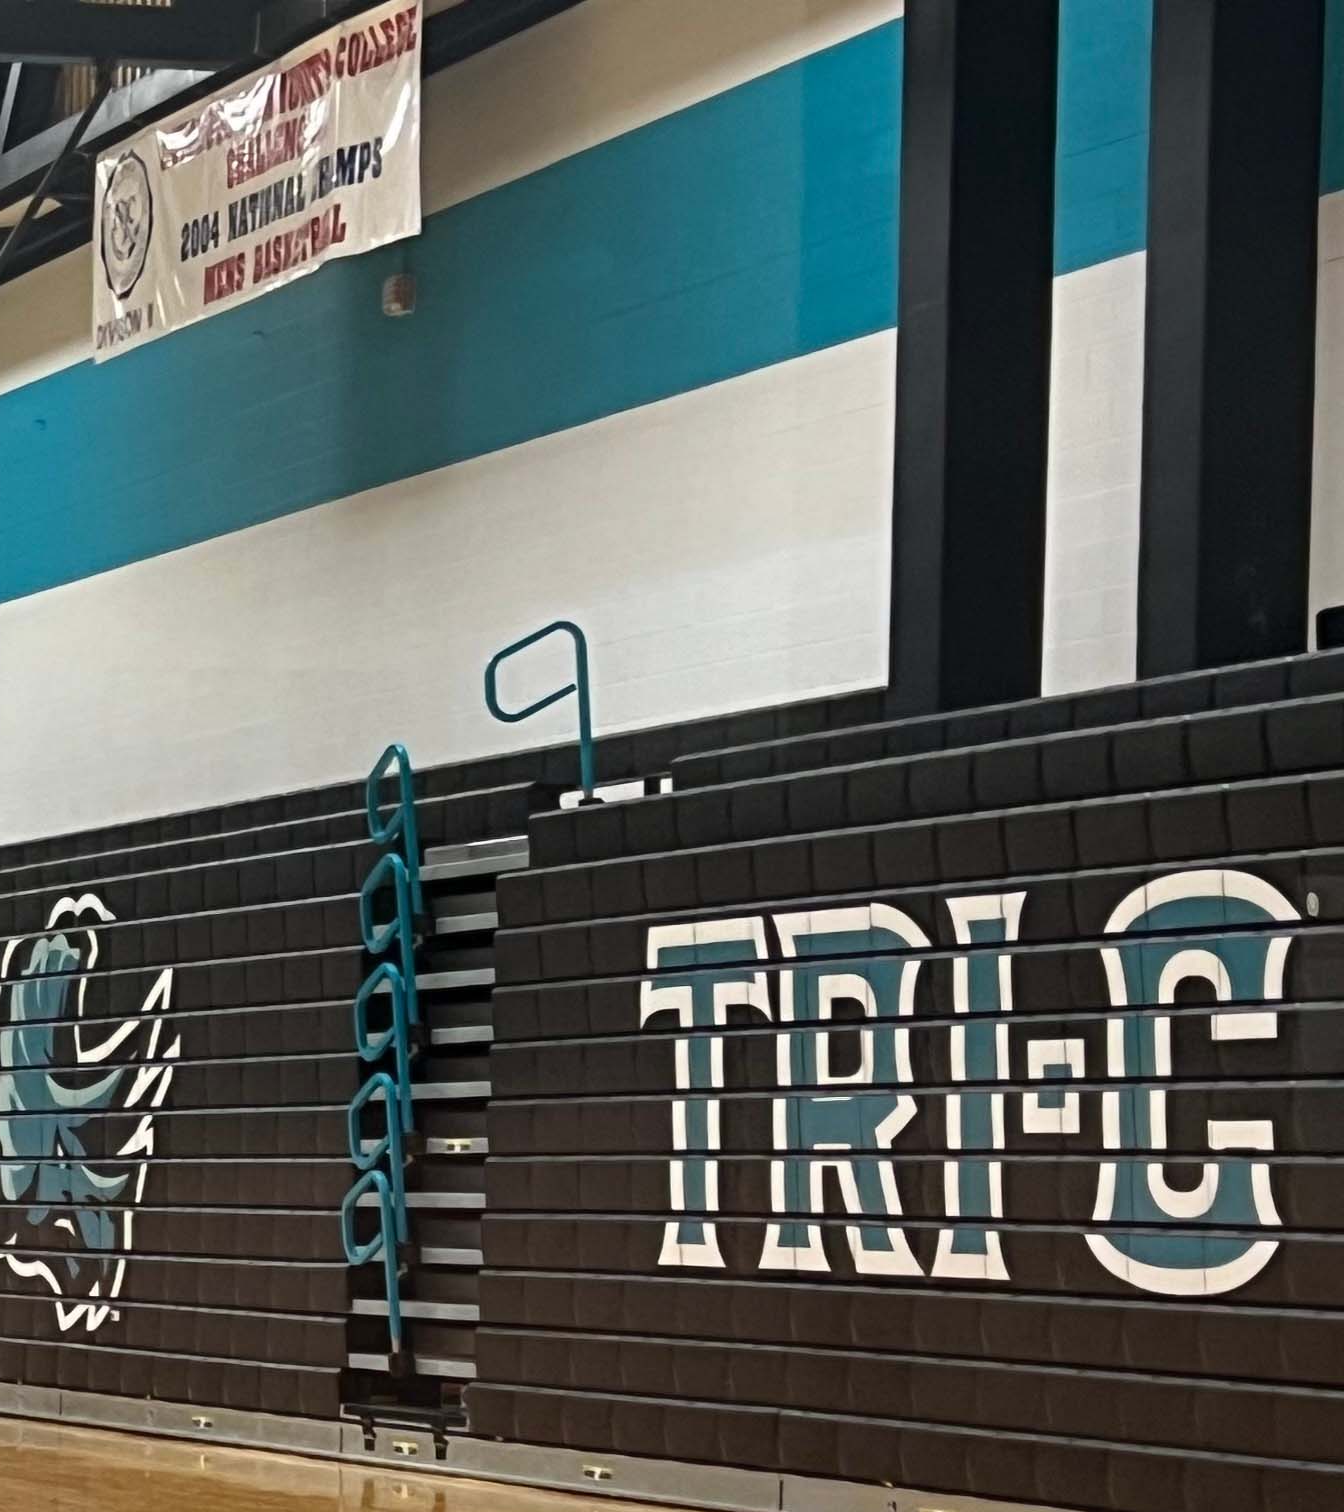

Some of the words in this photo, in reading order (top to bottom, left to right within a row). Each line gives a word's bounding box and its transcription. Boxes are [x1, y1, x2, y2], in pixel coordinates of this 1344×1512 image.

[334, 4, 417, 80] COLLEGE
[180, 210, 220, 263] 2004
[228, 171, 306, 243] NATIONAL
[311, 135, 383, 203] HAMPS
[640, 868, 1304, 1296] TRI-C
